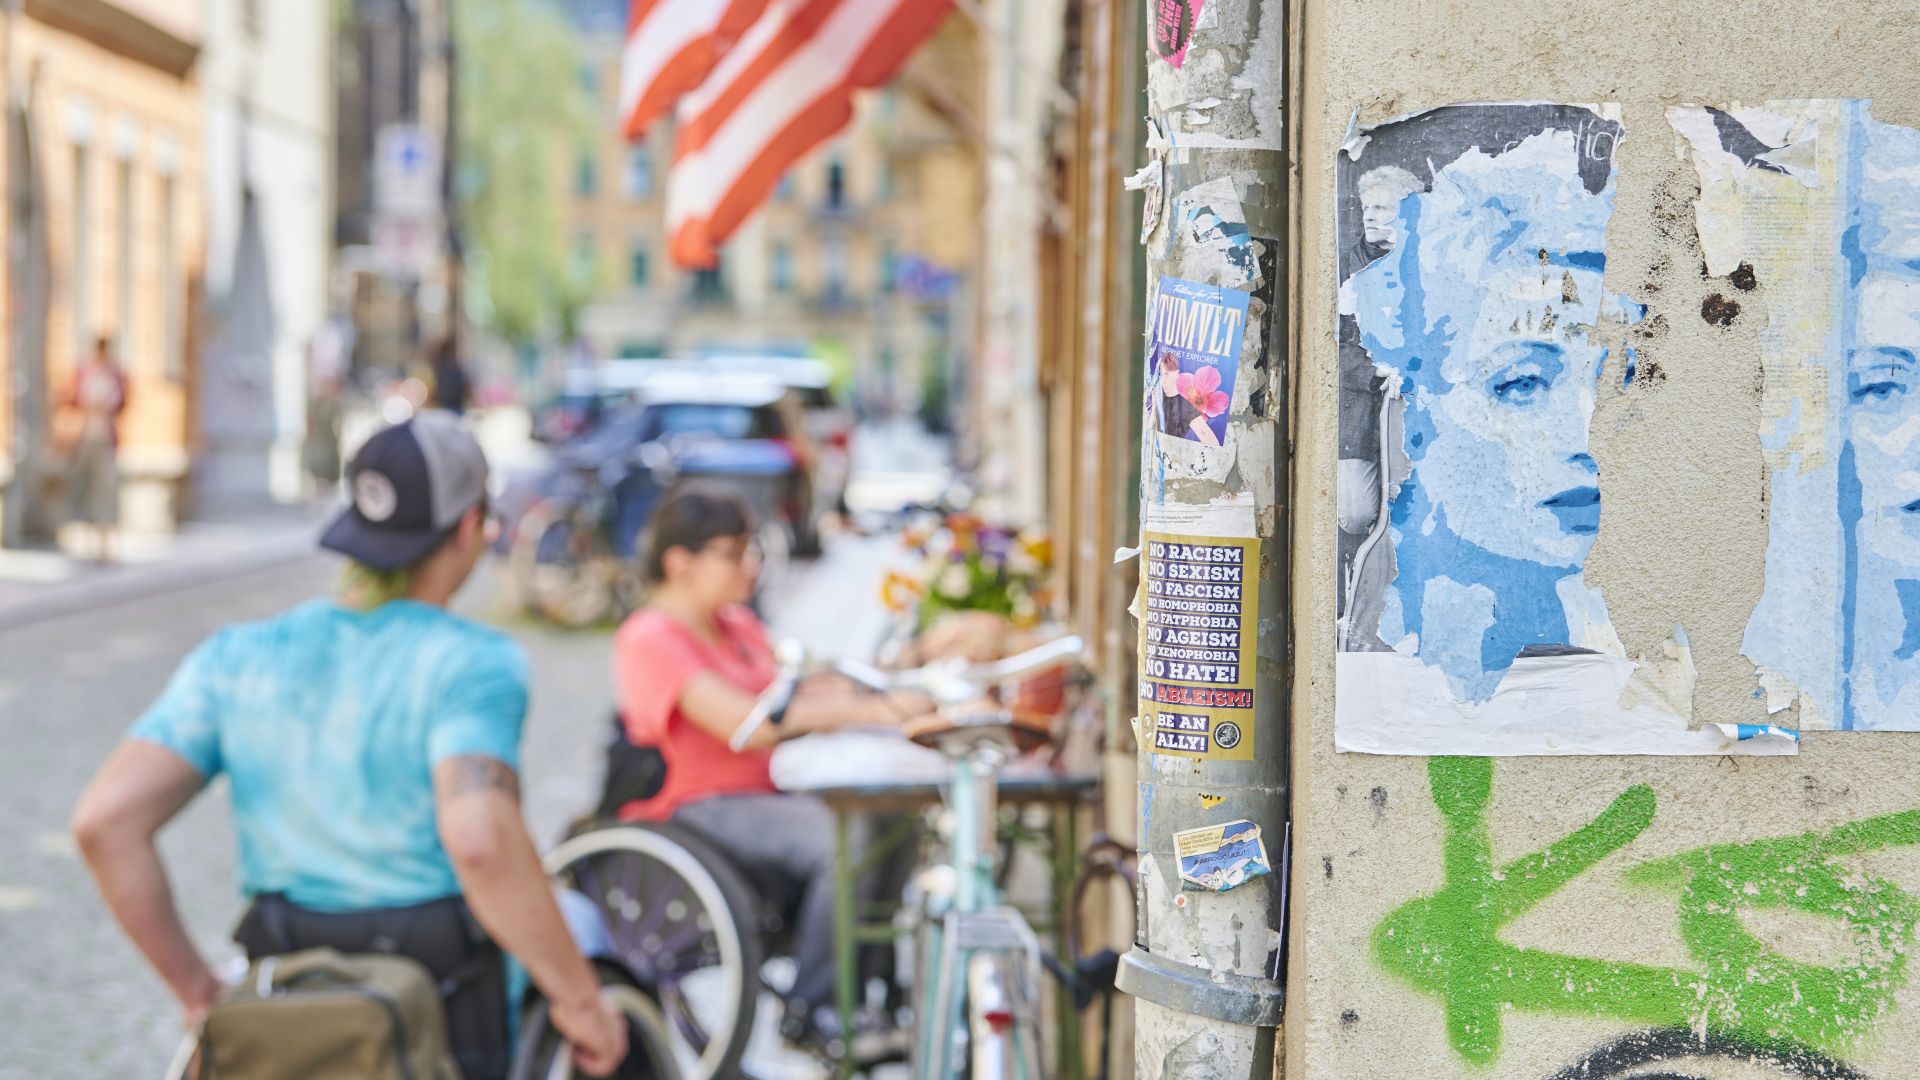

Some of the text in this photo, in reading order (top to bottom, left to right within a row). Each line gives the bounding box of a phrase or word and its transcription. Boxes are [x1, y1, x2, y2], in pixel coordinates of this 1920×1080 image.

[1170, 4, 1183, 50] HEIDI KLUM
[1186, 351, 1219, 366] EXPLORER
[1149, 542, 1241, 562] NO RACISM
[1149, 561, 1240, 581] NO SEXISM
[1148, 580, 1240, 599] NO FASCISM
[1148, 597, 1239, 613] NO HOMOPHOBIA
[1147, 611, 1239, 628] NO FATPHOBIA
[1147, 626, 1238, 647] NO AGEISM
[1147, 644, 1238, 662] NO XENOPHOBIA
[1145, 658, 1236, 682] NO HATE!
[1140, 681, 1252, 708] NO ABLEISM!
[1157, 713, 1175, 728] BE
[1179, 716, 1207, 730] AN
[1156, 732, 1206, 751] ALLY!
